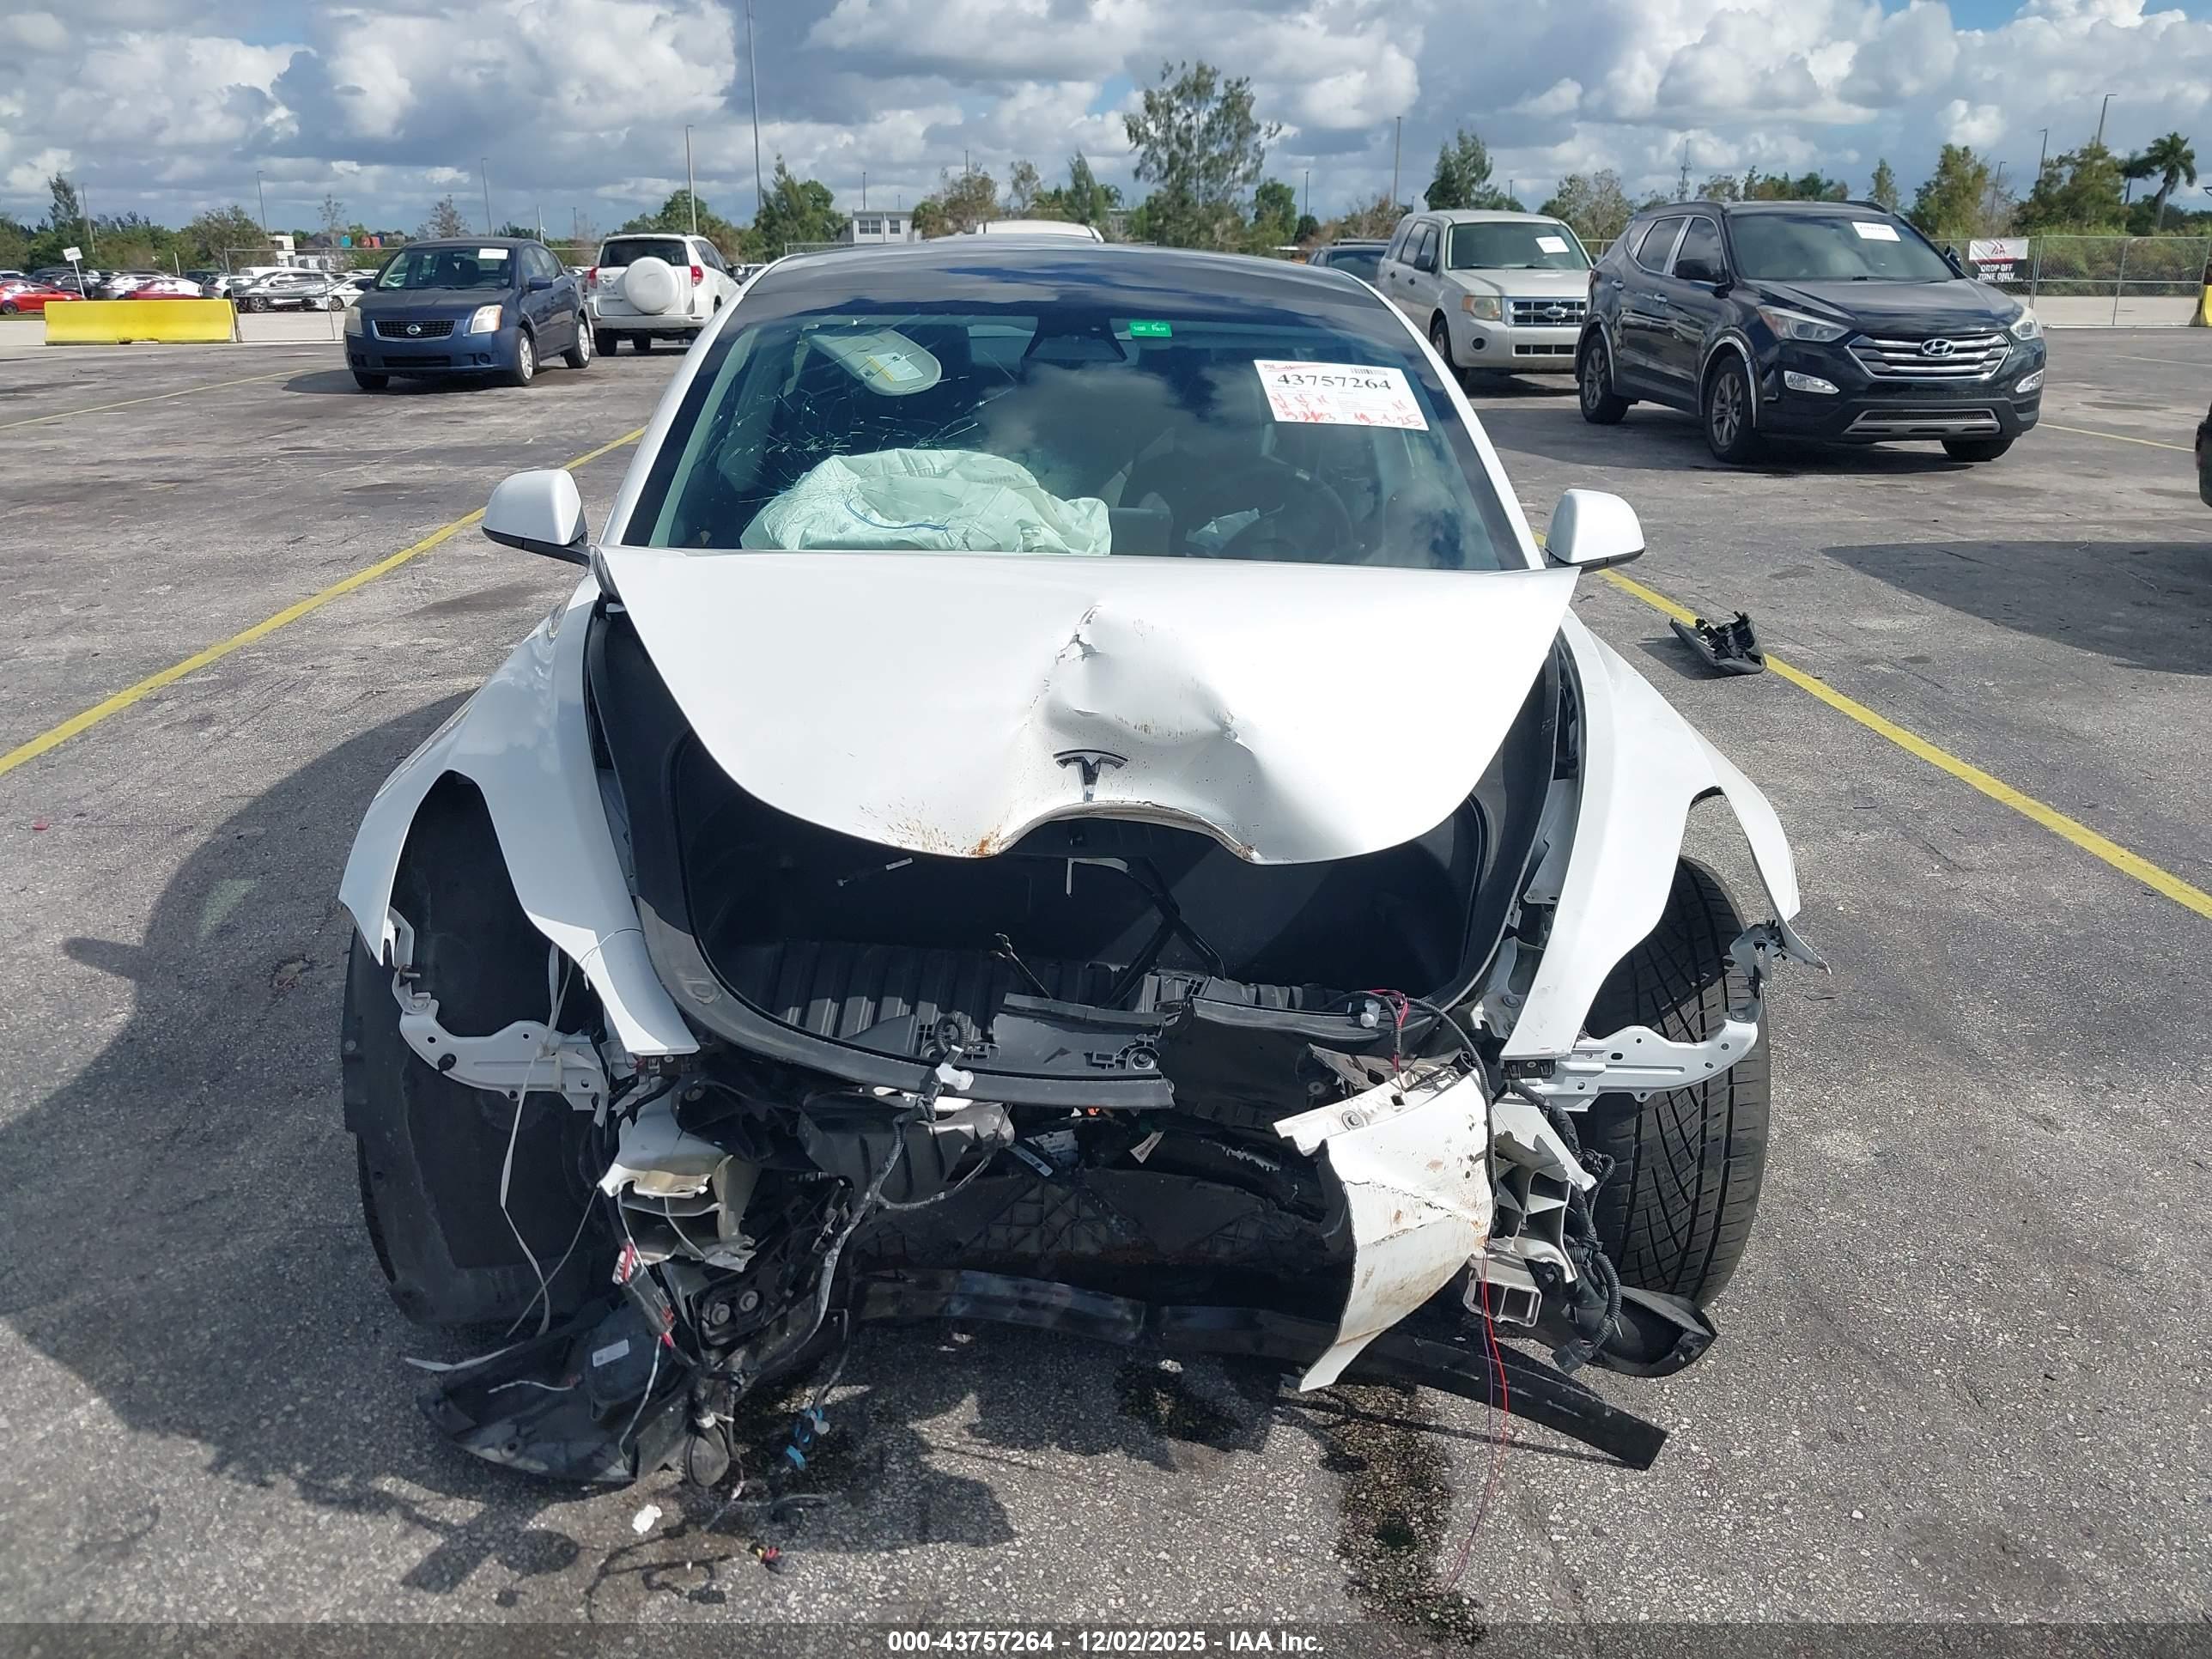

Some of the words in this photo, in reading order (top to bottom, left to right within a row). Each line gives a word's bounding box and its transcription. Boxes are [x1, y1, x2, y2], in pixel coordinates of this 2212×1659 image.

[1980, 264, 2000, 272] DROP
[2001, 263, 2014, 271] OFF
[1978, 272, 1996, 281] ZONE
[1996, 272, 2015, 283] ONLY
[1277, 374, 1392, 391] 43757264
